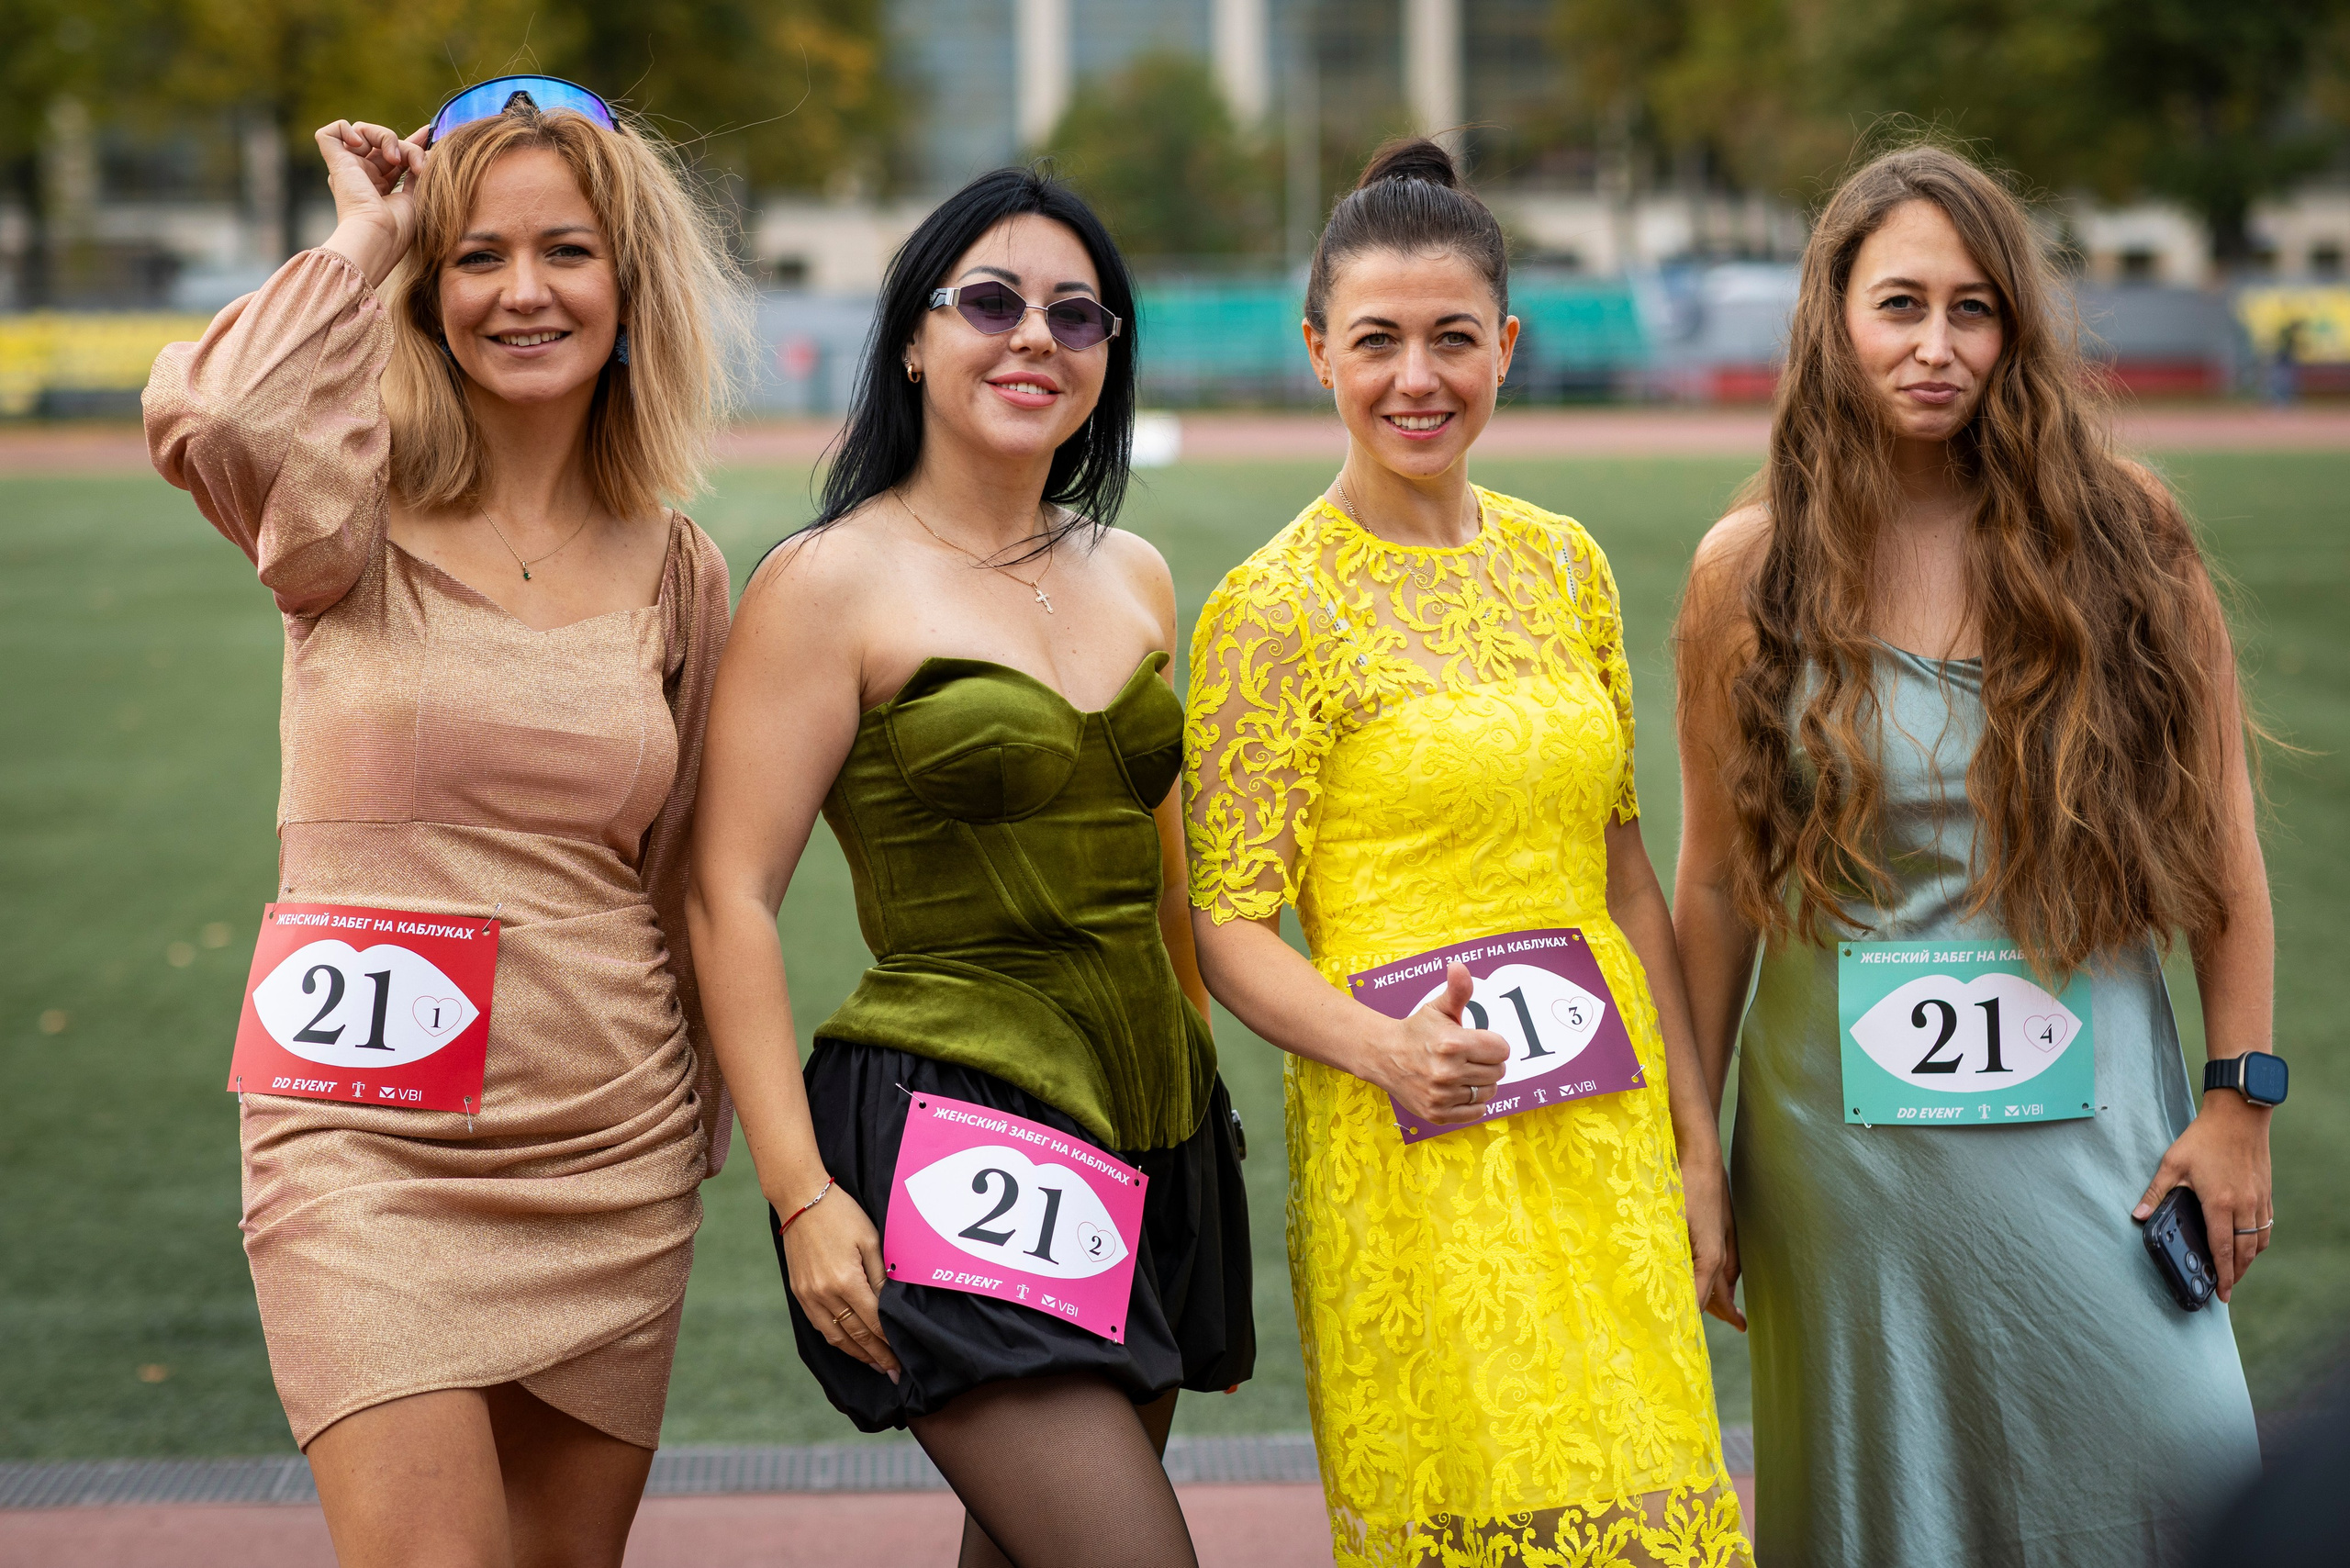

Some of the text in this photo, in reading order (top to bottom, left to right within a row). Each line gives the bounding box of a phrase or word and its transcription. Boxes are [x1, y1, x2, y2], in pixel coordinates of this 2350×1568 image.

[276, 913, 476, 940] ЖЕНСКИЙ ЗАБЕГ НА КАБЛУКАХ
[1373, 957, 1443, 990] ЖЕНСКИЙ
[1487, 945, 1505, 958] НА
[1506, 935, 1569, 953] КАБЛУКАХ
[1860, 949, 1930, 964] ЖЕНСКИЙ
[1931, 950, 1975, 964] ЗАБЕГ
[1975, 950, 1997, 962] НА
[292, 964, 396, 1052] 21
[431, 1007, 442, 1029] 1
[1568, 1006, 1583, 1025] 3
[1910, 996, 2014, 1074] 21
[2039, 1023, 2053, 1044] 4
[272, 1077, 291, 1089] DD
[292, 1078, 337, 1093] EVENT
[398, 1088, 422, 1101] VBI
[1483, 1096, 1521, 1116] VENT
[1574, 1080, 1597, 1094] VBI
[1897, 1107, 1917, 1119] DD
[1919, 1106, 1964, 1119] EVENT
[2021, 1104, 2043, 1115] VBI
[933, 1107, 1130, 1186] ЖЕНСКИЙ ЗАБЕГ НА КАБЛУКАХ
[957, 1168, 1063, 1265] 21
[1089, 1235, 1102, 1256] 2
[931, 1268, 954, 1282] DD
[955, 1272, 1003, 1291] EVENT
[1058, 1299, 1079, 1317] VBI
